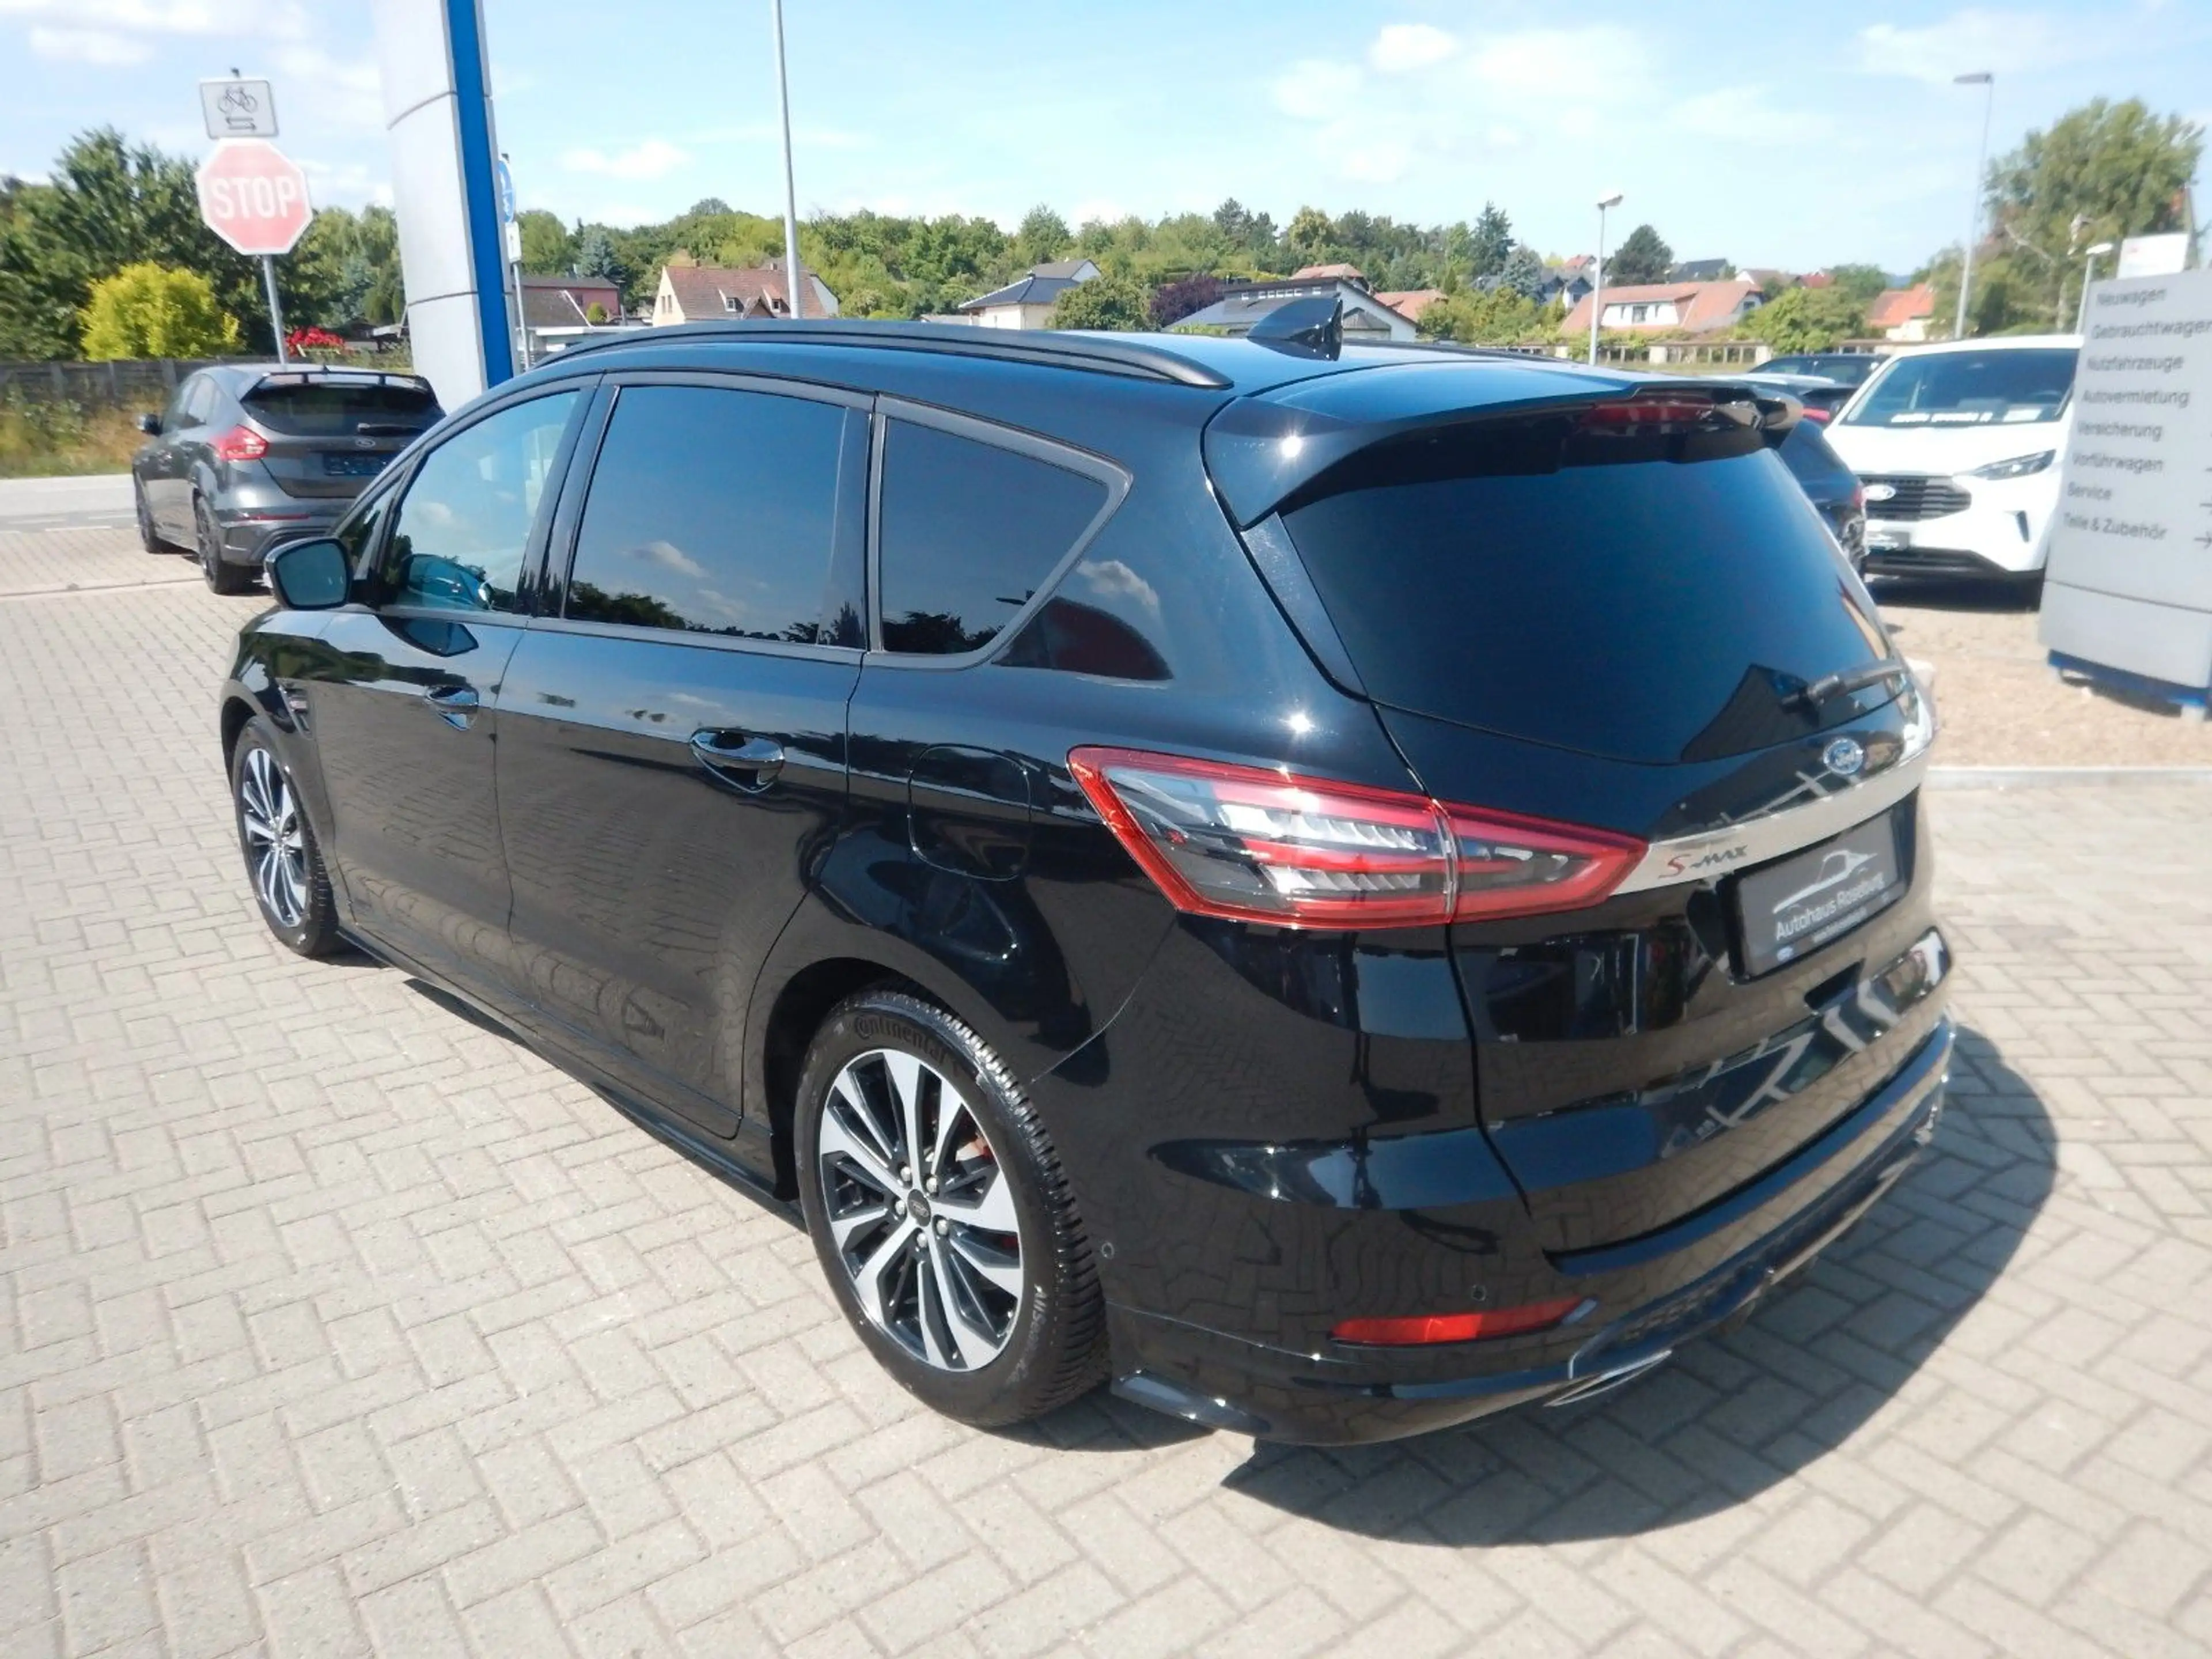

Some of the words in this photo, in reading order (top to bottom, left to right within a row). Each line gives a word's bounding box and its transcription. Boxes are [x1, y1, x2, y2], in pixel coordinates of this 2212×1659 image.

[211, 176, 297, 219] STOP
[2097, 289, 2167, 308] Neuwagen
[2088, 355, 2184, 373] Nutzfahrzeuge
[2081, 389, 2190, 409] Autovermietung
[2077, 420, 2162, 442] Versicherung
[2072, 451, 2164, 474] Vorführwagen
[2067, 482, 2112, 501] Service
[2063, 511, 2088, 531] Teile
[2090, 518, 2100, 532] &
[2103, 518, 2168, 540] Zubehör
[1776, 900, 1837, 941] Autohaus
